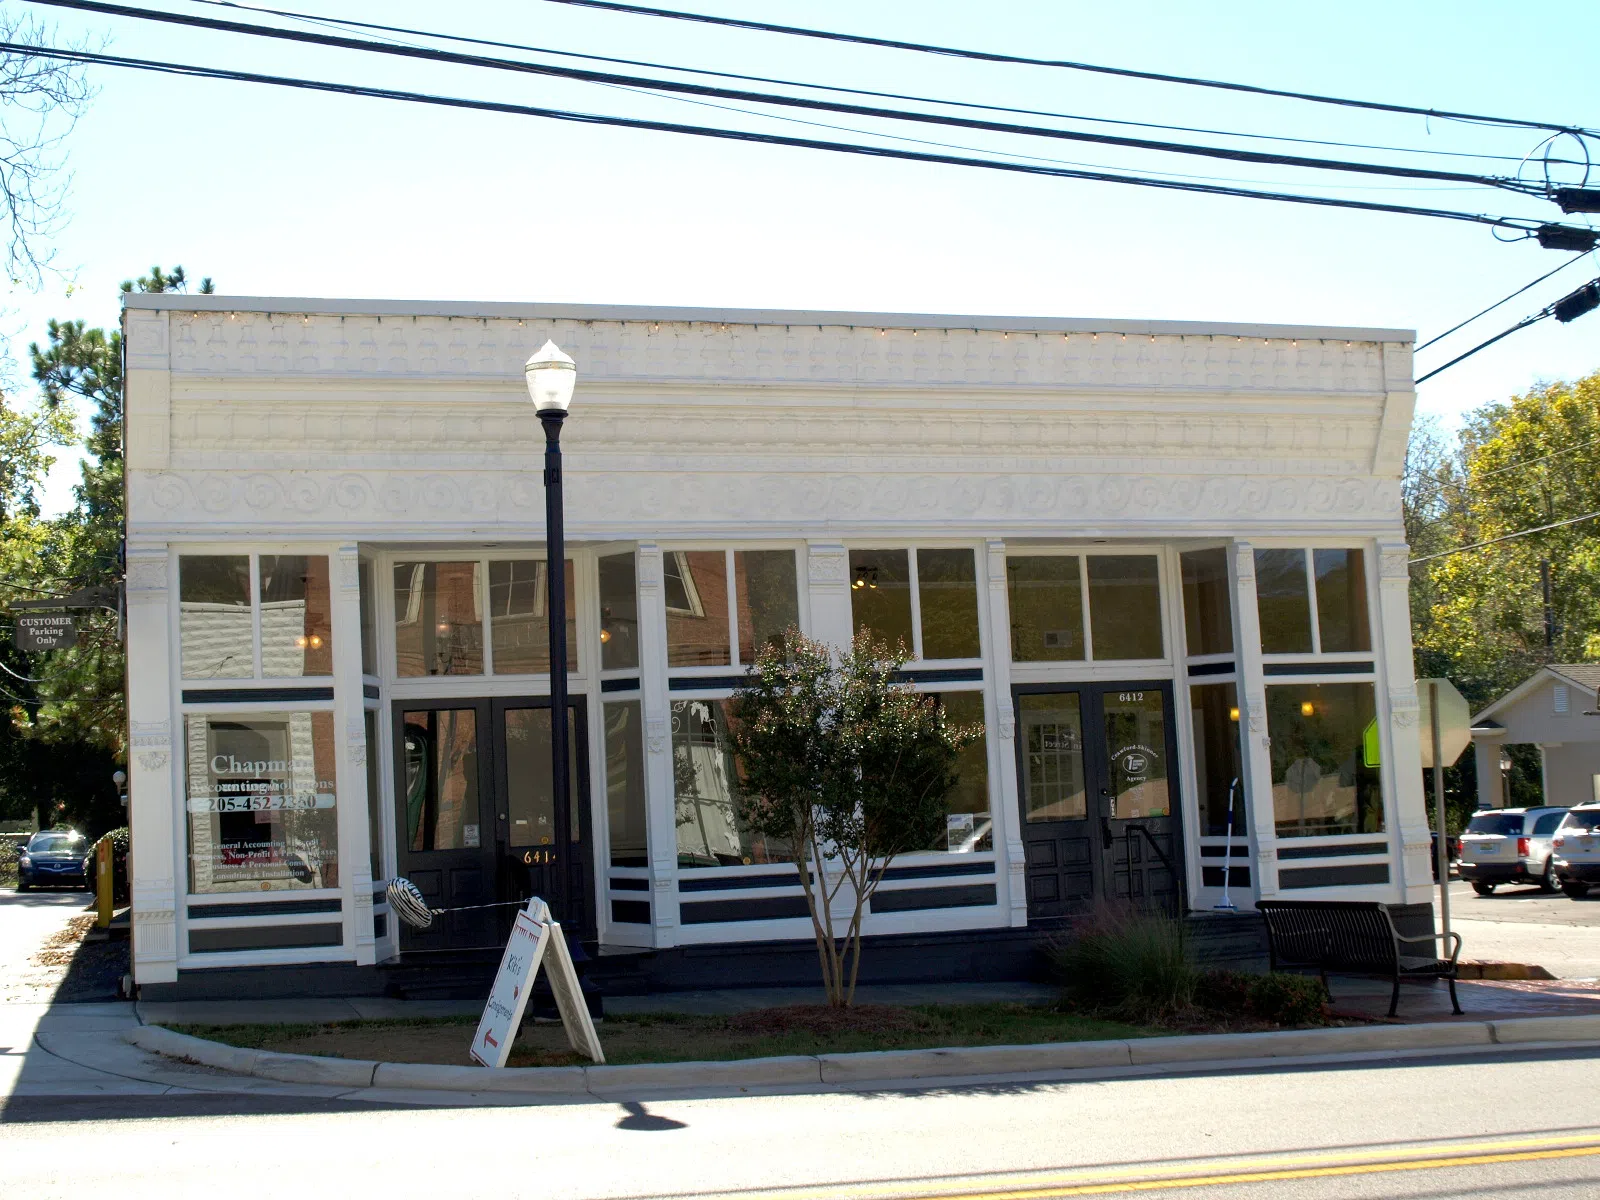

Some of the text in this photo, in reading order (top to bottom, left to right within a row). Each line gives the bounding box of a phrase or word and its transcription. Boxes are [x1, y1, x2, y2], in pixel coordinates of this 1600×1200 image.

[19, 617, 72, 627] CUSTOMER
[29, 627, 64, 636] Parking
[36, 636, 57, 645] Only
[1119, 692, 1143, 702] 6412
[242, 839, 285, 851] Accounting
[229, 851, 271, 860] Non-Profit
[524, 850, 556, 863] 641
